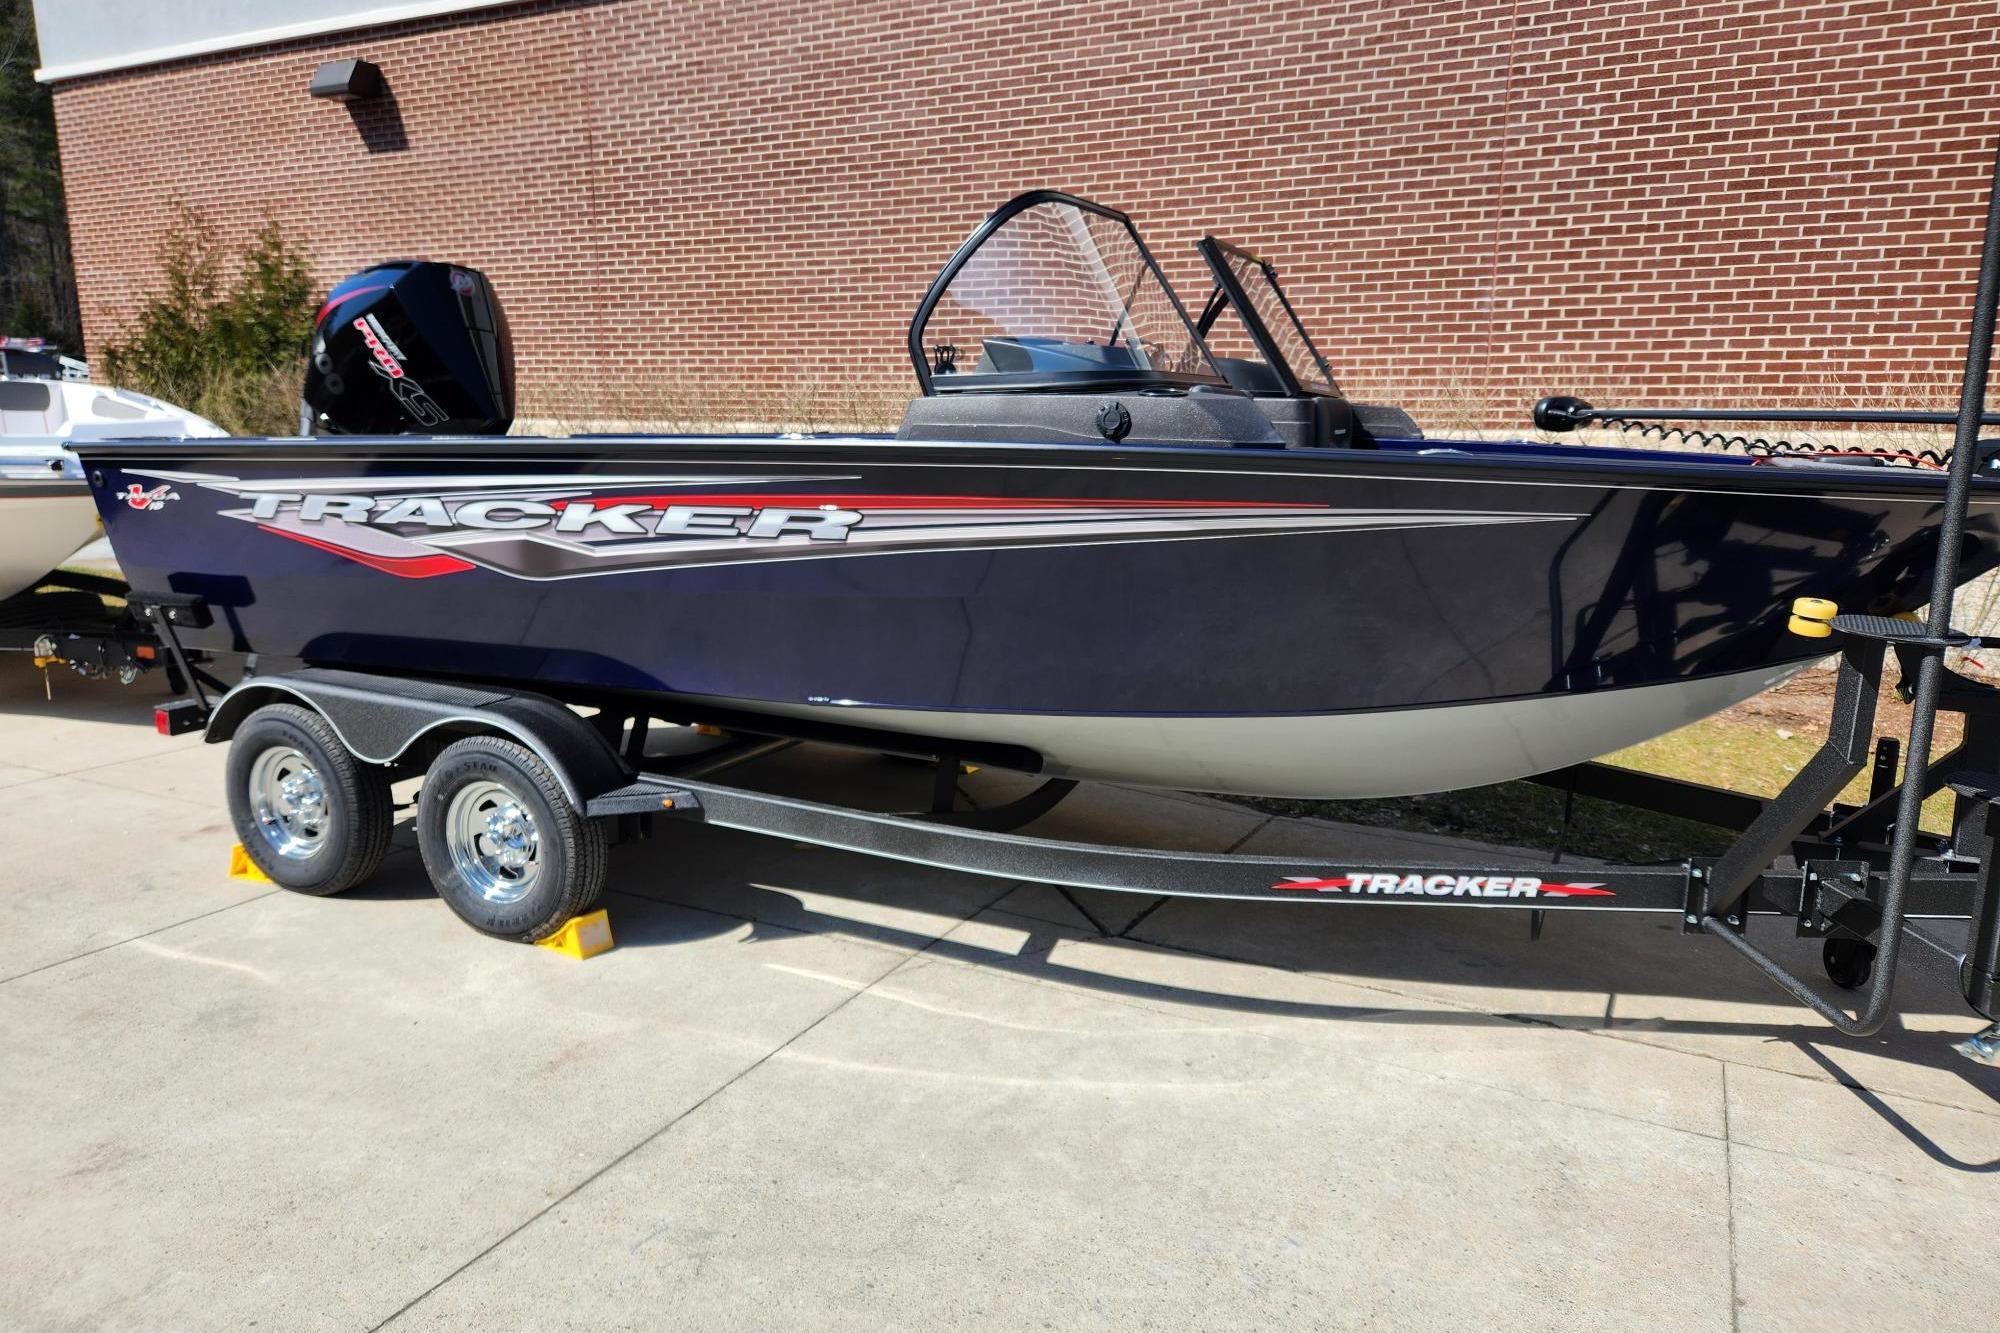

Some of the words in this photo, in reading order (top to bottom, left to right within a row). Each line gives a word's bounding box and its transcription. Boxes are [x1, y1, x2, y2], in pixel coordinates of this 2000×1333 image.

[368, 360, 449, 426] XS
[240, 492, 863, 540] TRACKER
[1346, 872, 1542, 897] TRACKER
